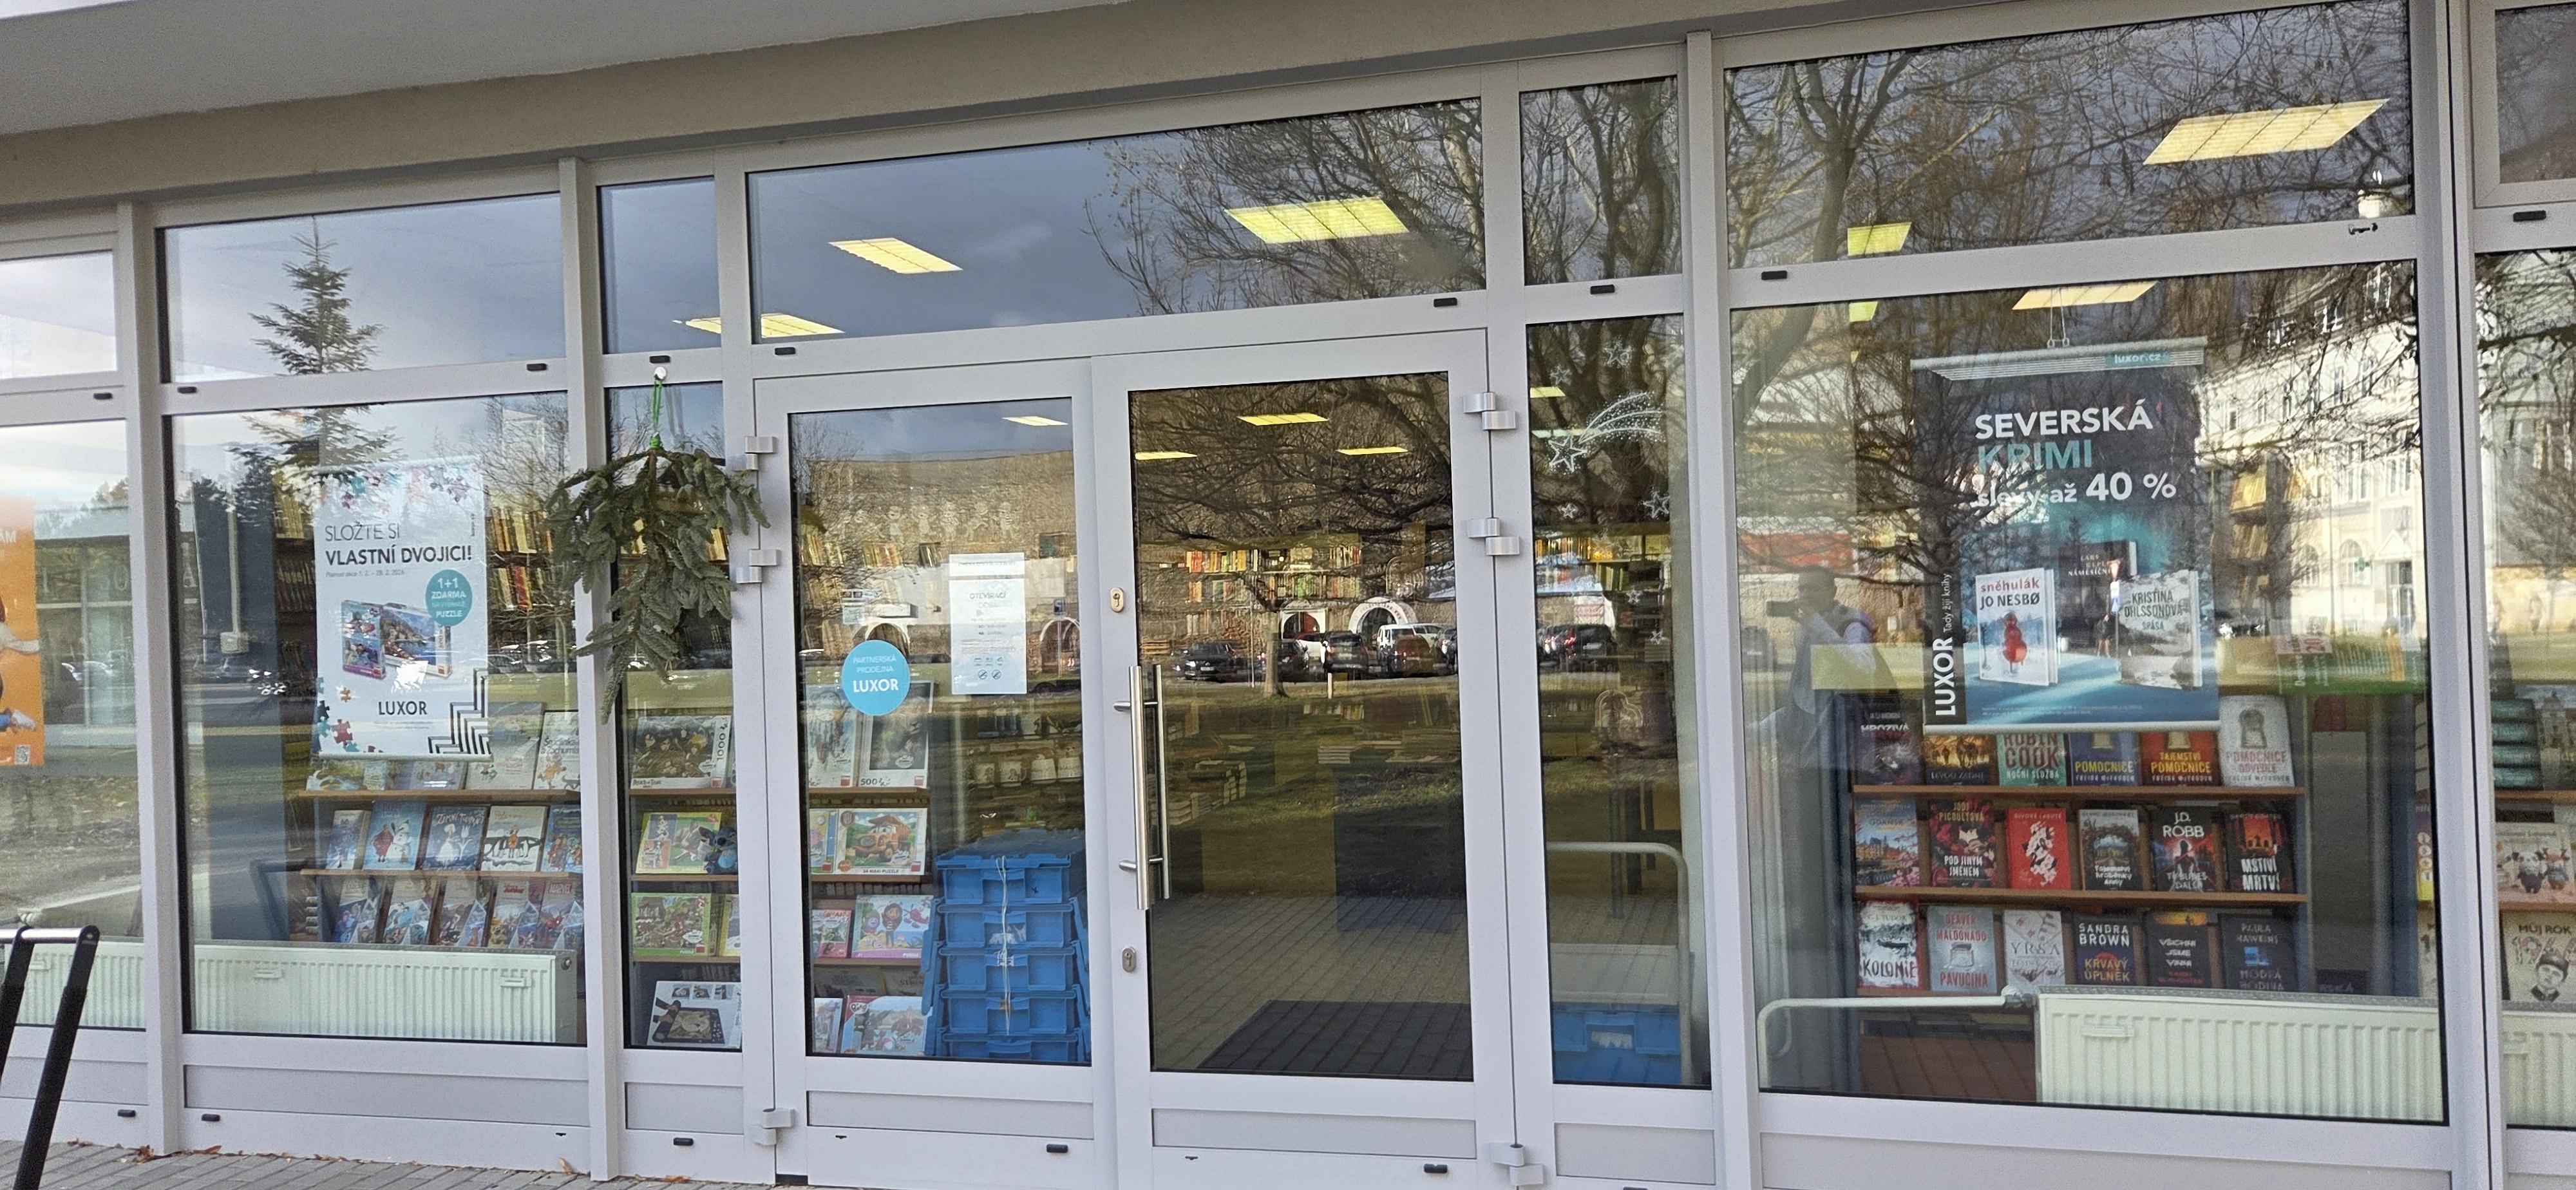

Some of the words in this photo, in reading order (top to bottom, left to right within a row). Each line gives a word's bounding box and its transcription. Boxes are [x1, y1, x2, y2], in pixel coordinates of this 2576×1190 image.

[2114, 353, 2161, 364] luxor.cz
[1975, 398, 2154, 440] SEVERSKÁ
[1977, 439, 2092, 474] KRIMI
[1977, 480, 2041, 509] slevy
[2050, 483, 2078, 504] až
[2085, 471, 2133, 502] 40
[2143, 472, 2177, 500] %
[325, 520, 383, 542] SLOŽTE
[388, 523, 400, 540] SI
[325, 545, 396, 565] VLASTNÍ
[401, 545, 472, 563] DVOJICI!
[438, 578, 459, 589] 1+1
[1941, 573, 1953, 596] knihy
[1980, 577, 2040, 592] sněhulák
[431, 590, 467, 599] ZDARMA
[969, 591, 1007, 600] OTEVÍRACÍ
[1979, 595, 1994, 610] JO
[1997, 592, 2040, 607] NESBØ
[2132, 590, 2174, 605] KRISTINA
[1942, 599, 1954, 610] žijí
[435, 610, 463, 618] PUZZLE
[1943, 612, 1954, 633] Tady
[2142, 619, 2164, 630] SPÁSA
[853, 654, 897, 664] PARTNERSKÁ
[1932, 637, 1956, 716] LUXOR
[853, 678, 899, 693] LUXOR
[378, 701, 428, 715] LUXOR
[2003, 733, 2058, 746] ROBIN
[717, 733, 726, 761] 1000
[2005, 746, 2060, 770] COOK
[2159, 751, 2201, 760] TAJEMSTVÍ
[2226, 751, 2287, 762] POMOCNICE
[2075, 760, 2135, 773] POMOCNICE
[2150, 761, 2211, 774] POMOCNICE
[2163, 825, 2205, 838] ROBB
[1944, 855, 1959, 865] POD
[1949, 865, 1980, 877] JMÉNEM
[2079, 923, 2129, 934] SANDRA
[2241, 923, 2271, 933] PAULA
[2545, 925, 2571, 934] ROK
[1936, 929, 1987, 941] MALDONADO
[2079, 933, 2130, 948] BROWN
[1863, 958, 1917, 978] KOLONIE
[2085, 957, 2128, 971] KRVAVÝ
